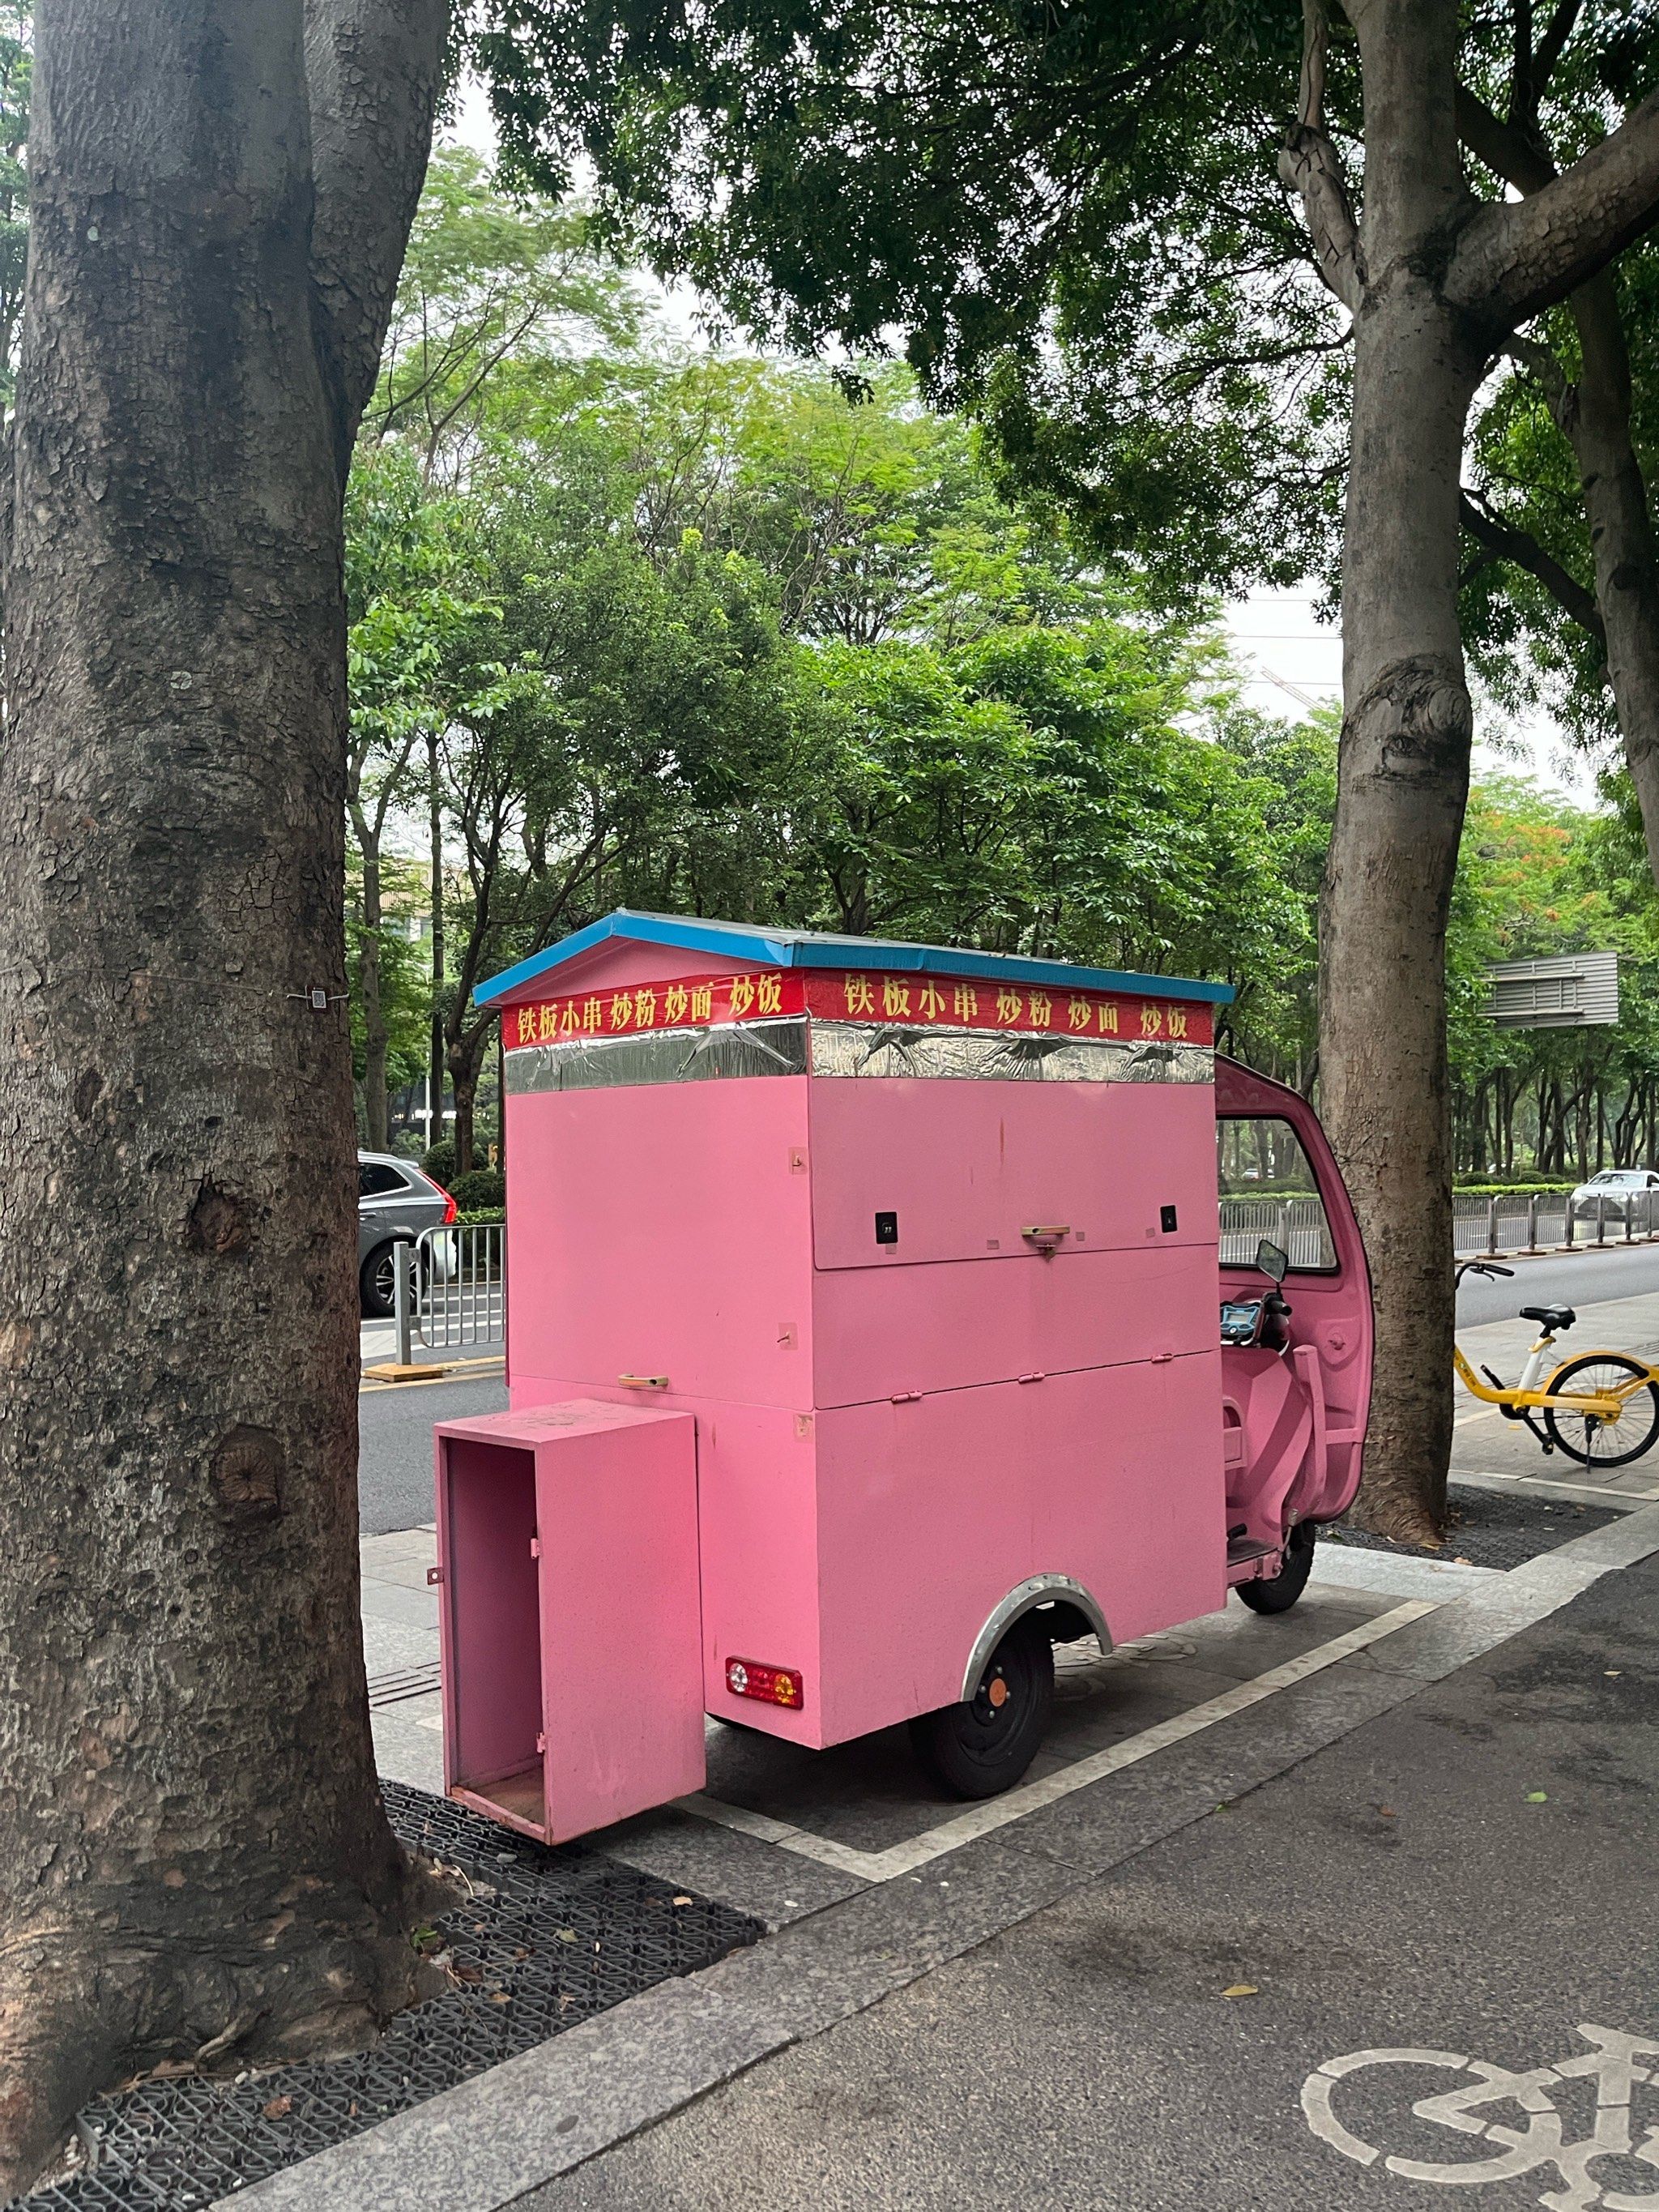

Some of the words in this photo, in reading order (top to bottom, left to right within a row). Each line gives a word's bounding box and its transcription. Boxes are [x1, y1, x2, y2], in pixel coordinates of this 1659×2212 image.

[518, 996, 603, 1044] 铁板小串
[609, 987, 658, 1030] 炒粉
[665, 981, 714, 1024] 炒面
[729, 971, 783, 1016] 炒饭
[843, 972, 978, 1022] 铁板小串
[996, 986, 1052, 1027] 炒粉
[1068, 995, 1119, 1034] 炒面
[1139, 1005, 1188, 1039] 炒饭
